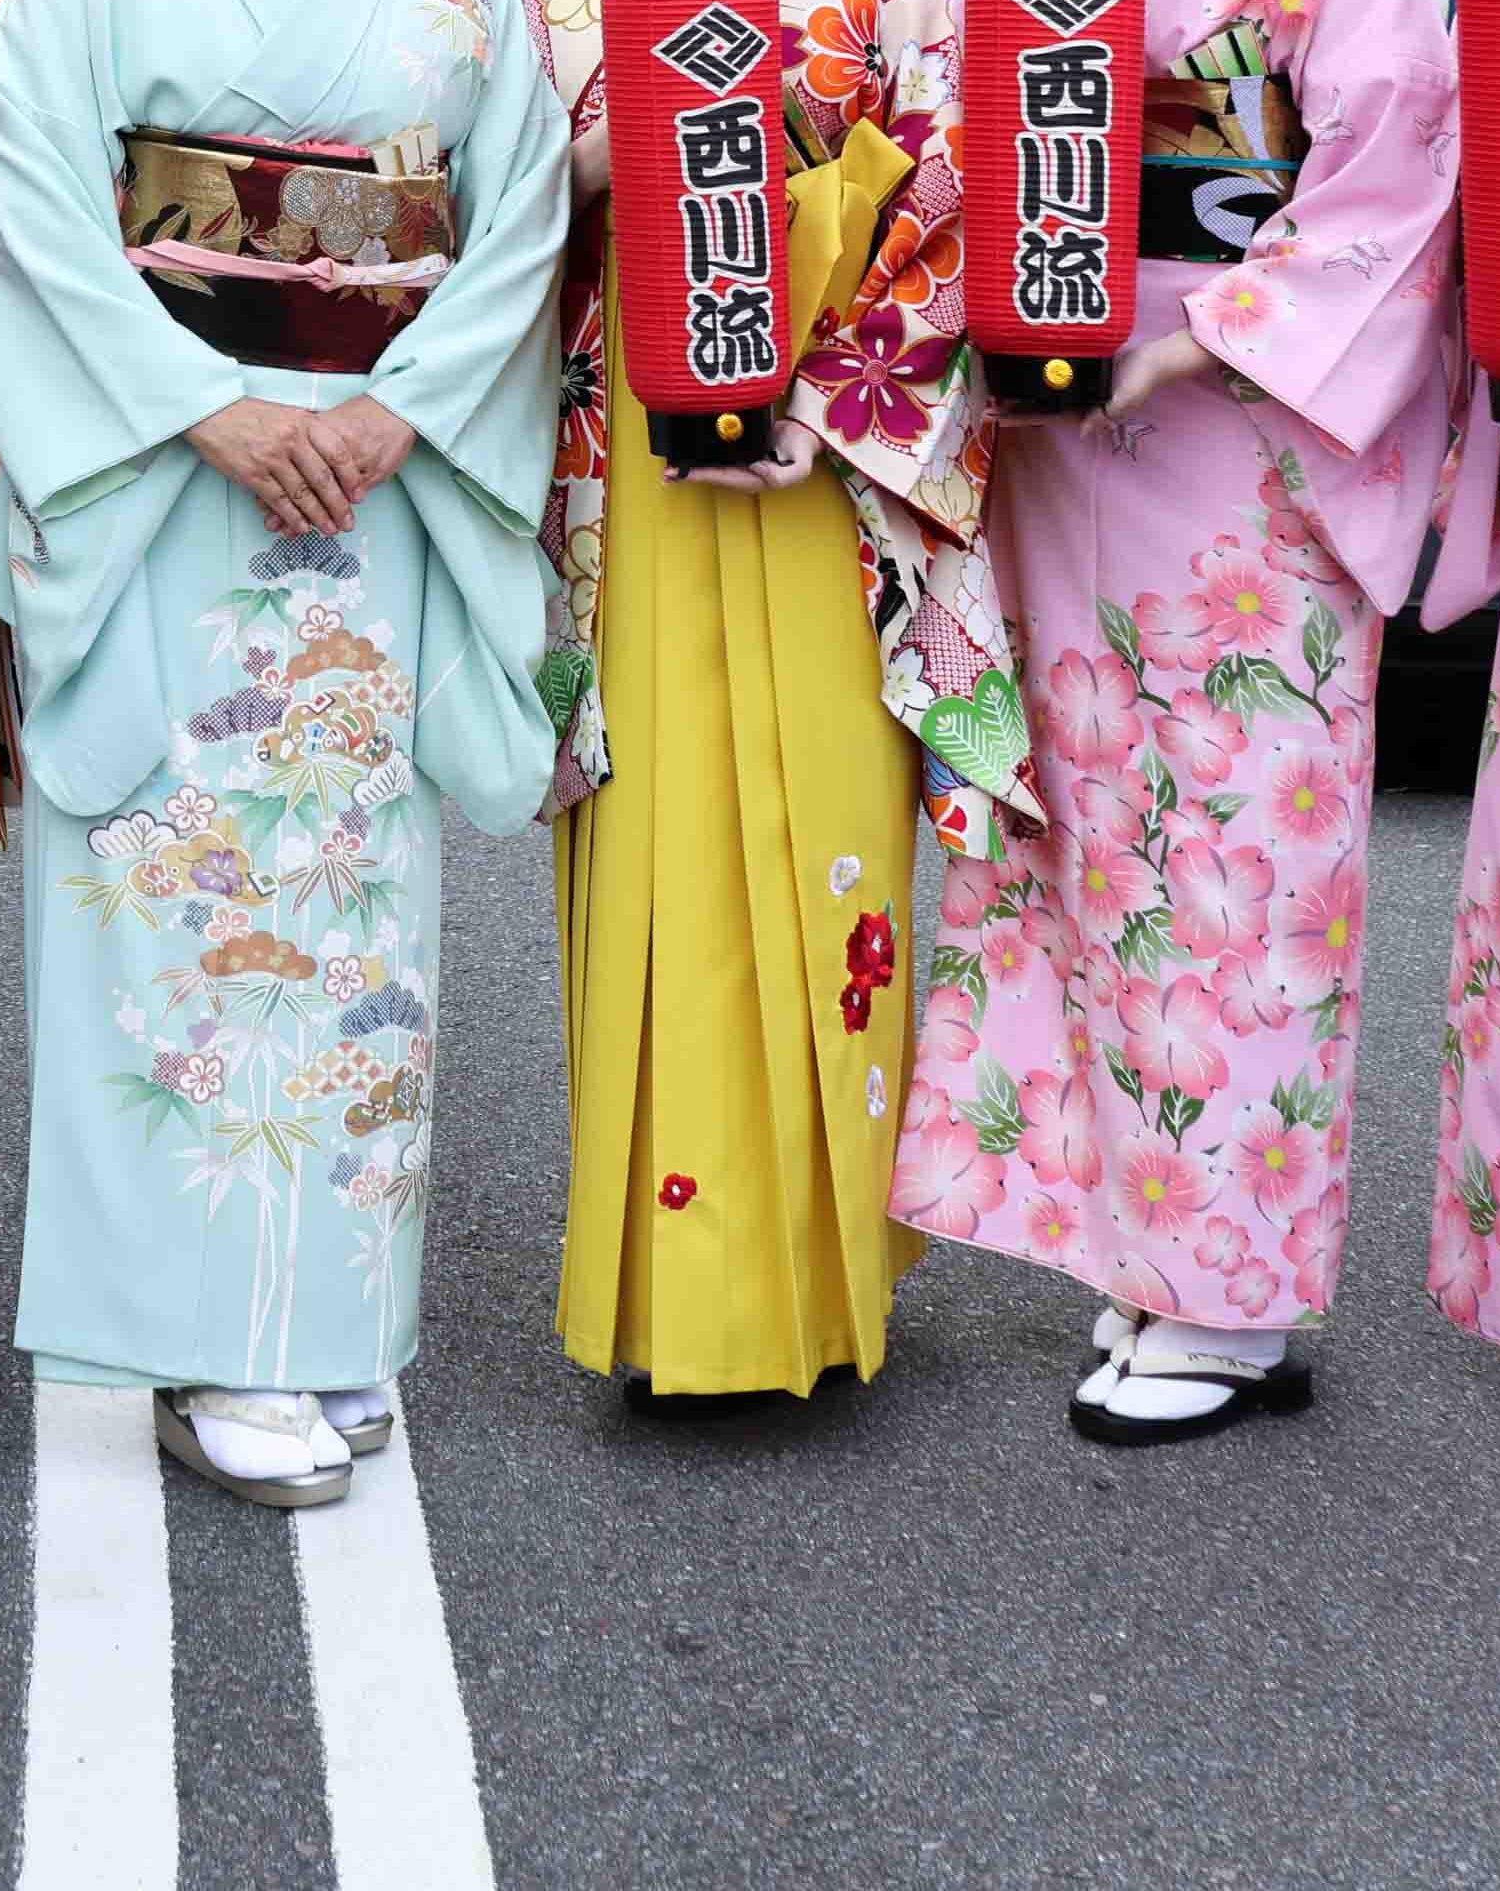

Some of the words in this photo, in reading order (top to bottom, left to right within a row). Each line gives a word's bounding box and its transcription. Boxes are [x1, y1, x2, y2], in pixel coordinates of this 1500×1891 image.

[675, 94, 779, 386] 西川流
[1011, 40, 1113, 325] 西川流
